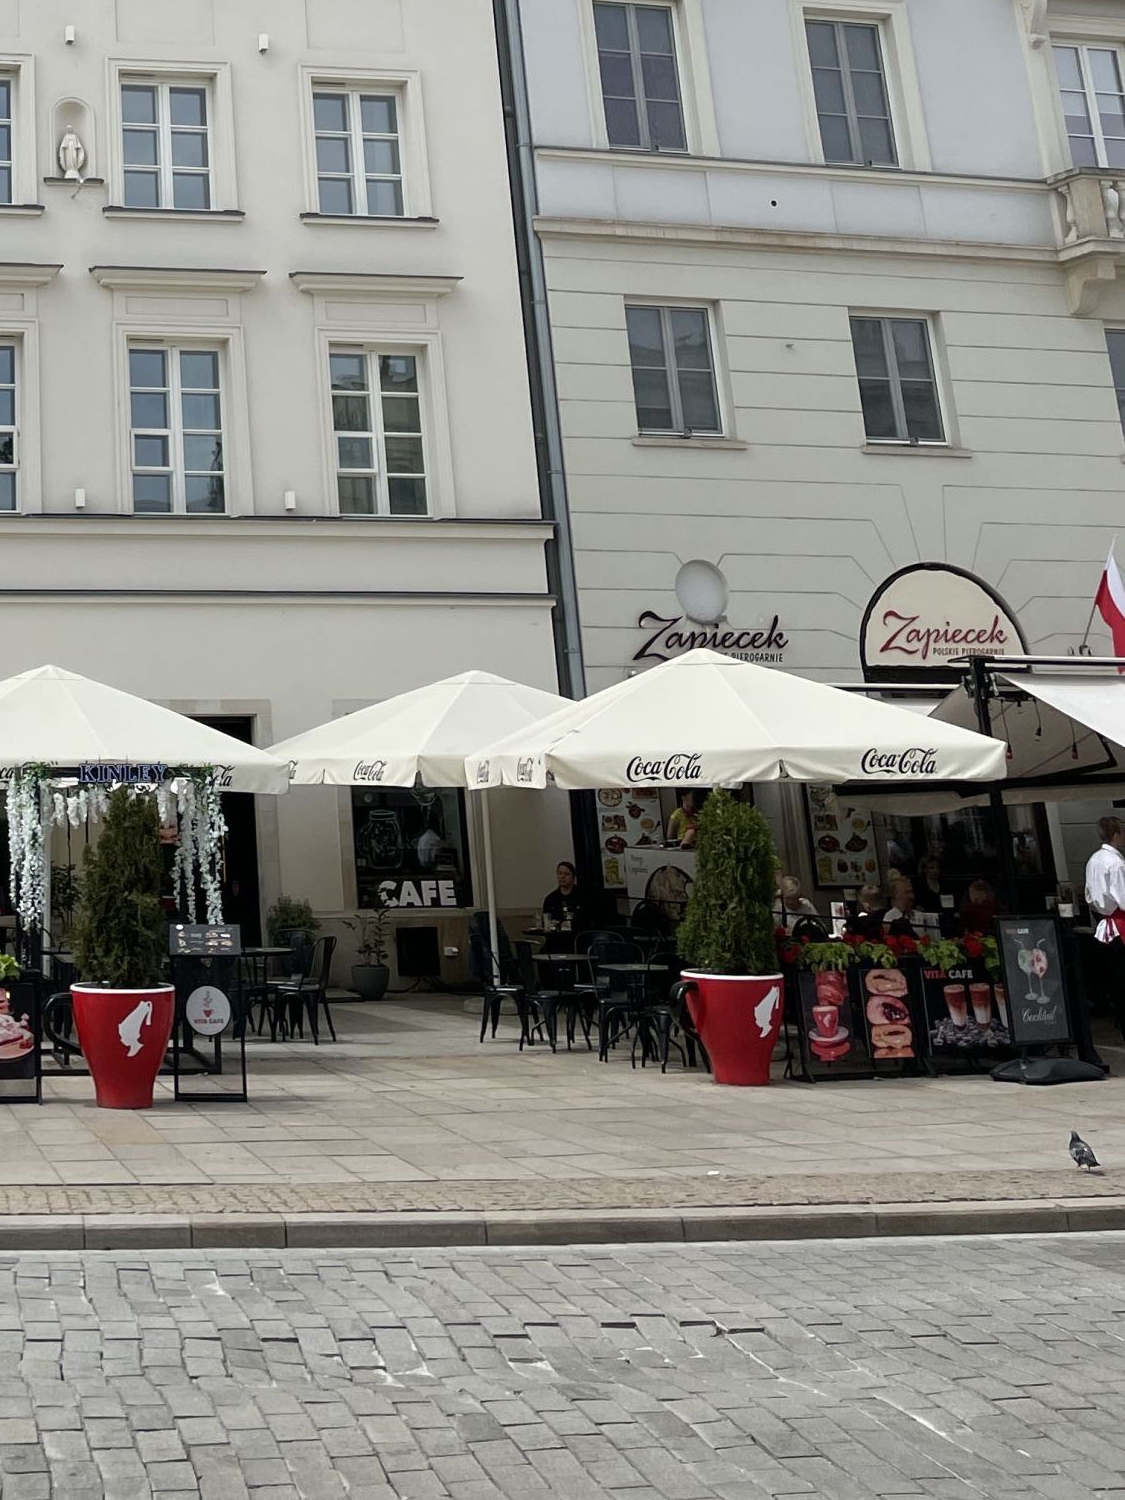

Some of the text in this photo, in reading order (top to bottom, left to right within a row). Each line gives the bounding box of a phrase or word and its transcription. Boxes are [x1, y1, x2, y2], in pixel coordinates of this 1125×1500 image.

[632, 610, 789, 661] Zapiecek
[879, 610, 1008, 660] Zapiecek
[932, 647, 959, 656] POLSKIE
[79, 763, 168, 783] KINLEY
[626, 752, 702, 783] Coca-Cola
[861, 747, 939, 775] Coca-Cola
[378, 880, 457, 907] CAFE
[948, 969, 973, 979] CAFE
